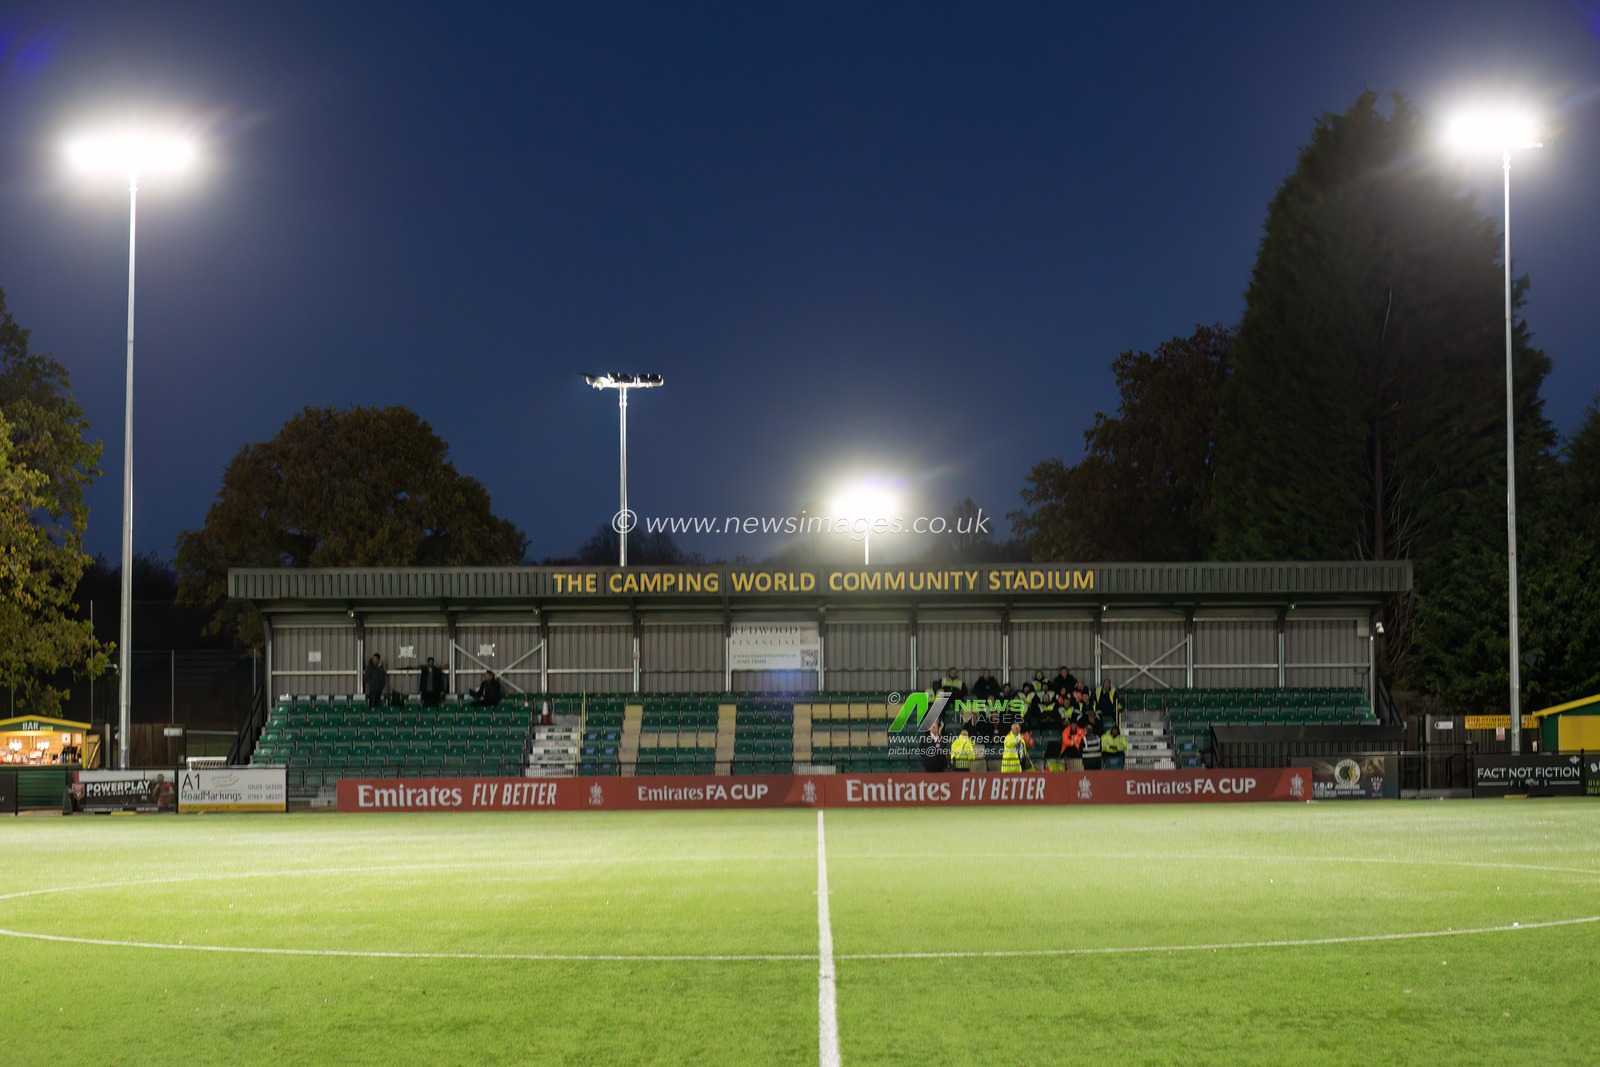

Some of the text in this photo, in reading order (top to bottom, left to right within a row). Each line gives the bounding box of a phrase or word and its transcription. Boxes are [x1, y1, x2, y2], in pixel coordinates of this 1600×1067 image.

[553, 570, 1094, 593] THE CAMPING WORLD COMMUNITY STADIUM
[22, 721, 39, 731] BAR
[181, 773, 200, 790] A1
[1477, 766, 1580, 779] FACT NOT FICTION
[86, 780, 151, 793] POWERPLAY
[357, 782, 557, 808] Emirates FLY BETTER
[637, 783, 769, 802] Emirates FA CUP
[846, 777, 1046, 802] Emirates FLY BETTER
[1126, 777, 1257, 796] Emirates FA CUP
[181, 790, 242, 803] RoadMarkings
